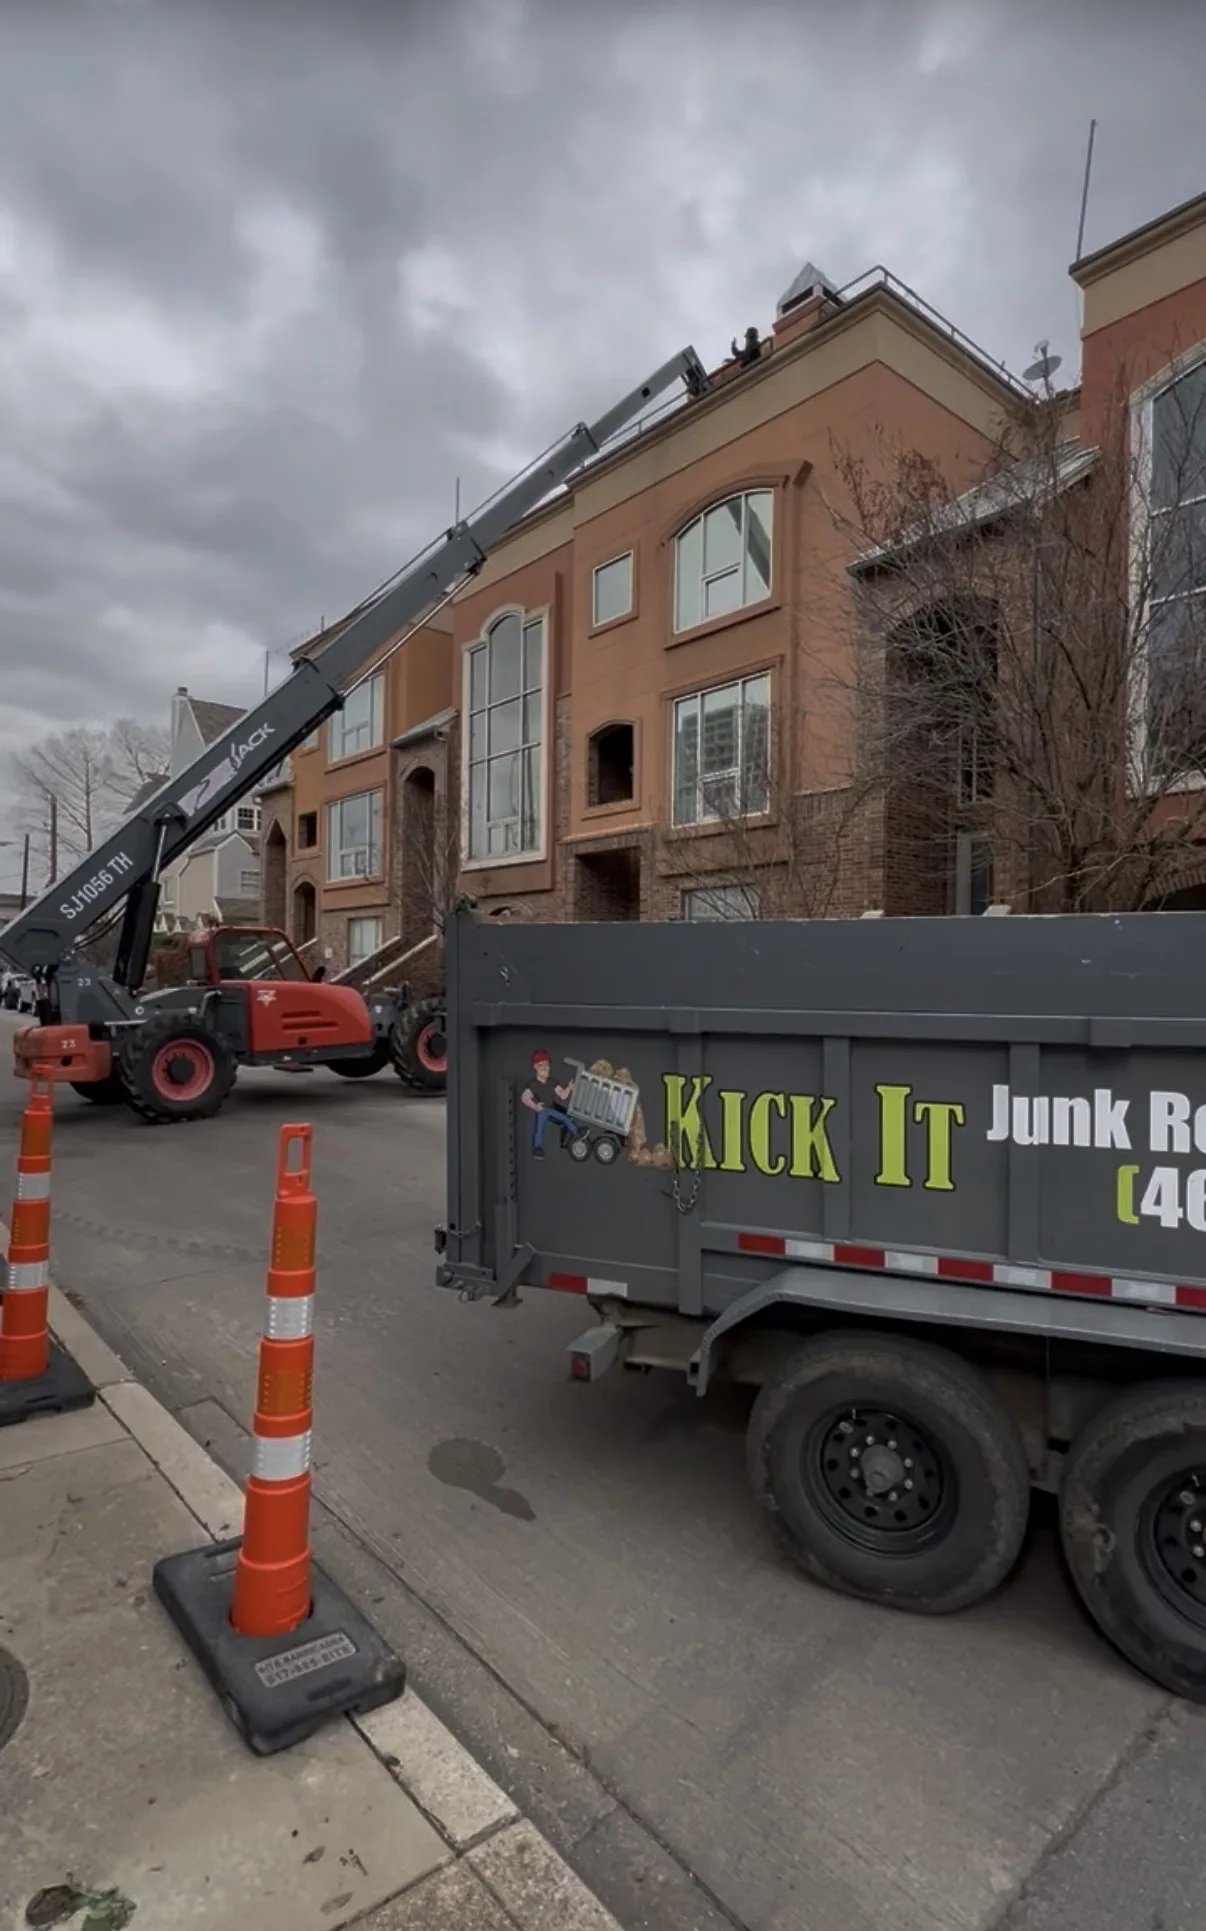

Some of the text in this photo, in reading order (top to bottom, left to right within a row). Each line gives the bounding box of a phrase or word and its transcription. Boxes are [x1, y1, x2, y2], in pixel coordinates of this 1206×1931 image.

[60, 851, 134, 919] SJ1056 TH
[986, 1084, 1206, 1154] Junk R
